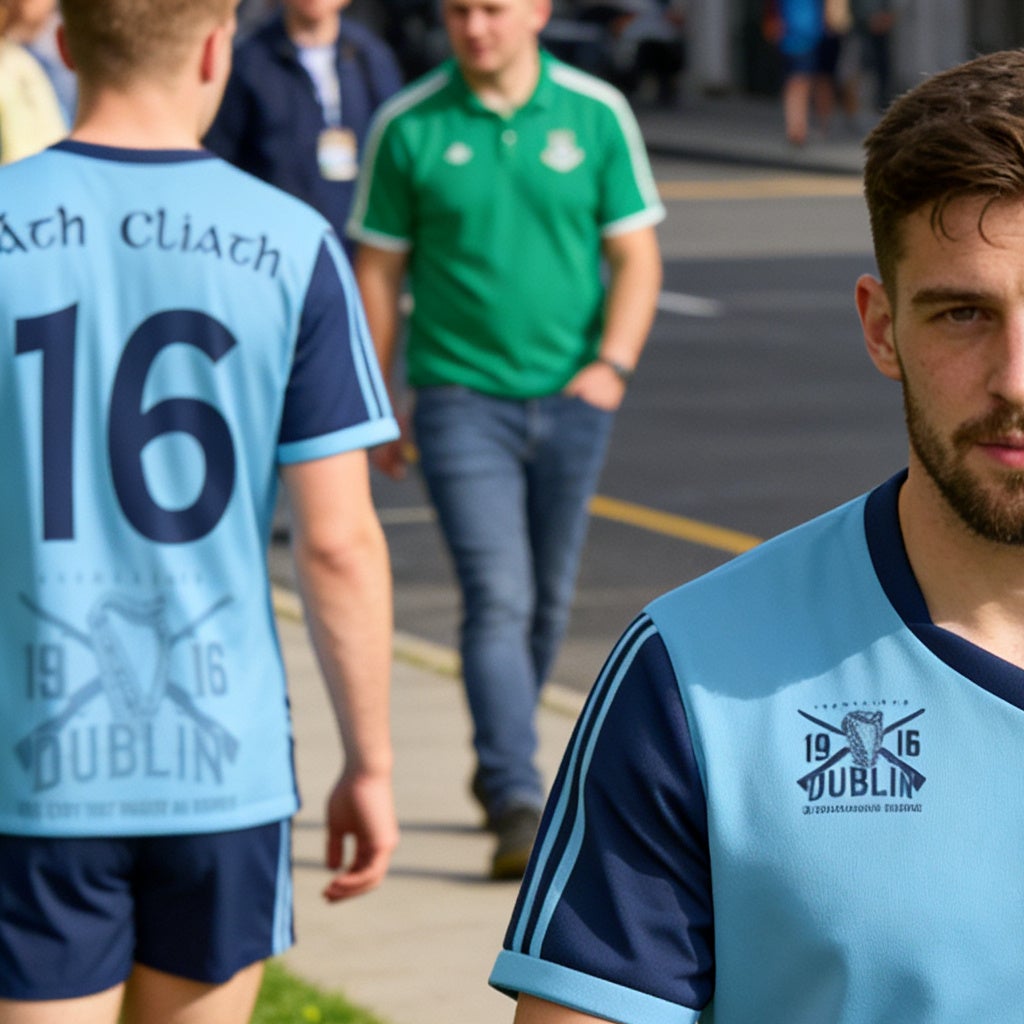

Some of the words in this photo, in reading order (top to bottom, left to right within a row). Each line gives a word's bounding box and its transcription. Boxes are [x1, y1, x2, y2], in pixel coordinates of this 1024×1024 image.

[14, 301, 238, 544] 16
[25, 643, 63, 700] 19
[192, 641, 228, 697] 16
[33, 723, 224, 792] DUBLIN
[805, 733, 831, 763] 19
[897, 729, 921, 757] 16
[808, 766, 913, 801] DUBLIN
